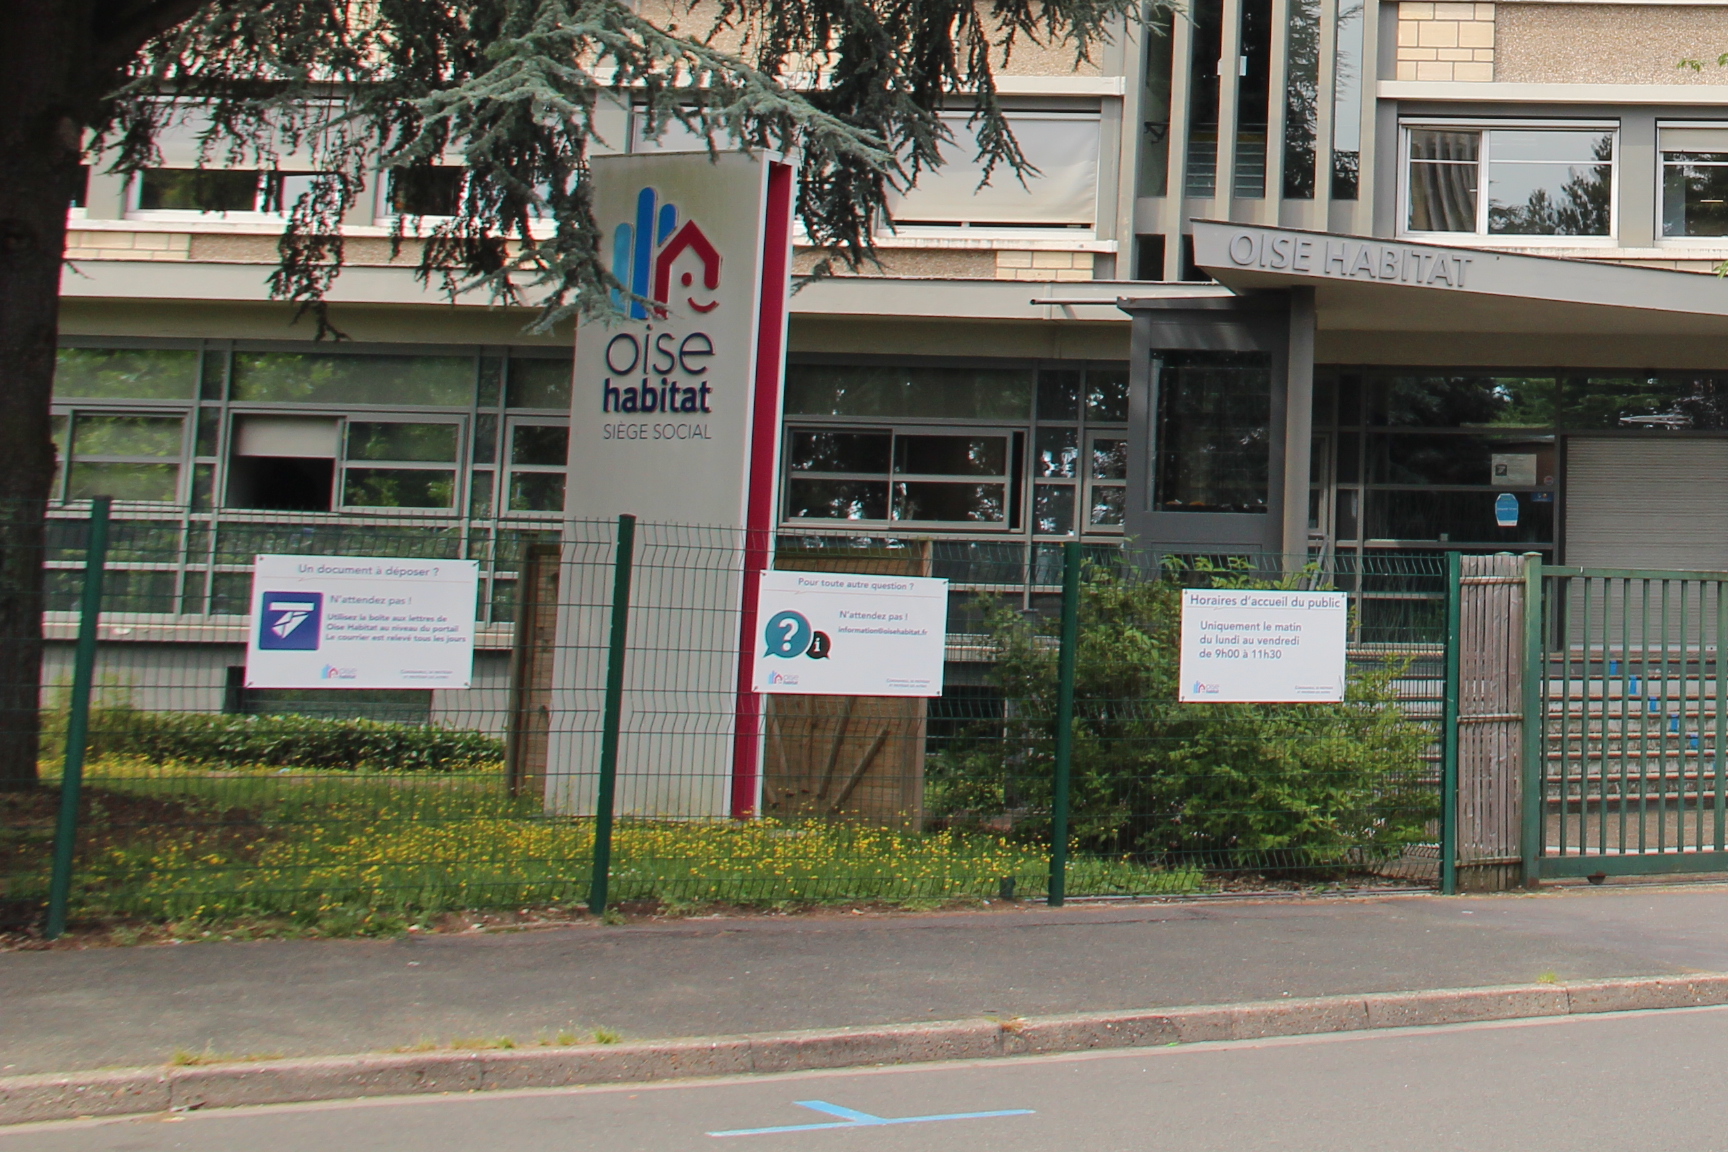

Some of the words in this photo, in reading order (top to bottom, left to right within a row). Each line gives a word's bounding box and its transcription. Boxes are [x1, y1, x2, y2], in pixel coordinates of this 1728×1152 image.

[1229, 230, 1312, 272] OISE
[1324, 240, 1473, 287] HABITAT
[606, 324, 716, 376] oise
[602, 376, 713, 414] habitat
[603, 420, 648, 440] SIÈGE
[652, 423, 712, 440] SOCIAL
[299, 564, 314, 573] Un
[318, 565, 372, 574] document
[376, 566, 381, 575] à
[386, 566, 429, 578] déposer
[434, 568, 439, 576] ?
[798, 578, 818, 586] Pour
[821, 579, 844, 588] toute
[847, 581, 868, 589] autre
[872, 582, 907, 591] question
[330, 595, 386, 605] N'attendez
[389, 598, 406, 606] pas
[1190, 594, 1237, 606] Horaires
[1240, 596, 1288, 608] d'accueil
[1291, 596, 1304, 607] du
[1308, 597, 1341, 609] public
[839, 610, 886, 620] N'attendez
[888, 613, 903, 622] pas
[838, 627, 928, 636] information@oisehabitat.fr
[1200, 620, 1261, 633] Uniquement
[1263, 621, 1272, 632] le
[1275, 622, 1302, 632] matin
[778, 618, 799, 651] ?
[1200, 634, 1213, 644] du
[1216, 634, 1240, 645] lundi
[1257, 636, 1300, 646] vendredi
[1199, 648, 1212, 659] de
[1215, 649, 1240, 659] 9h00
[1243, 649, 1249, 659] à
[1253, 650, 1282, 659] 11h30
